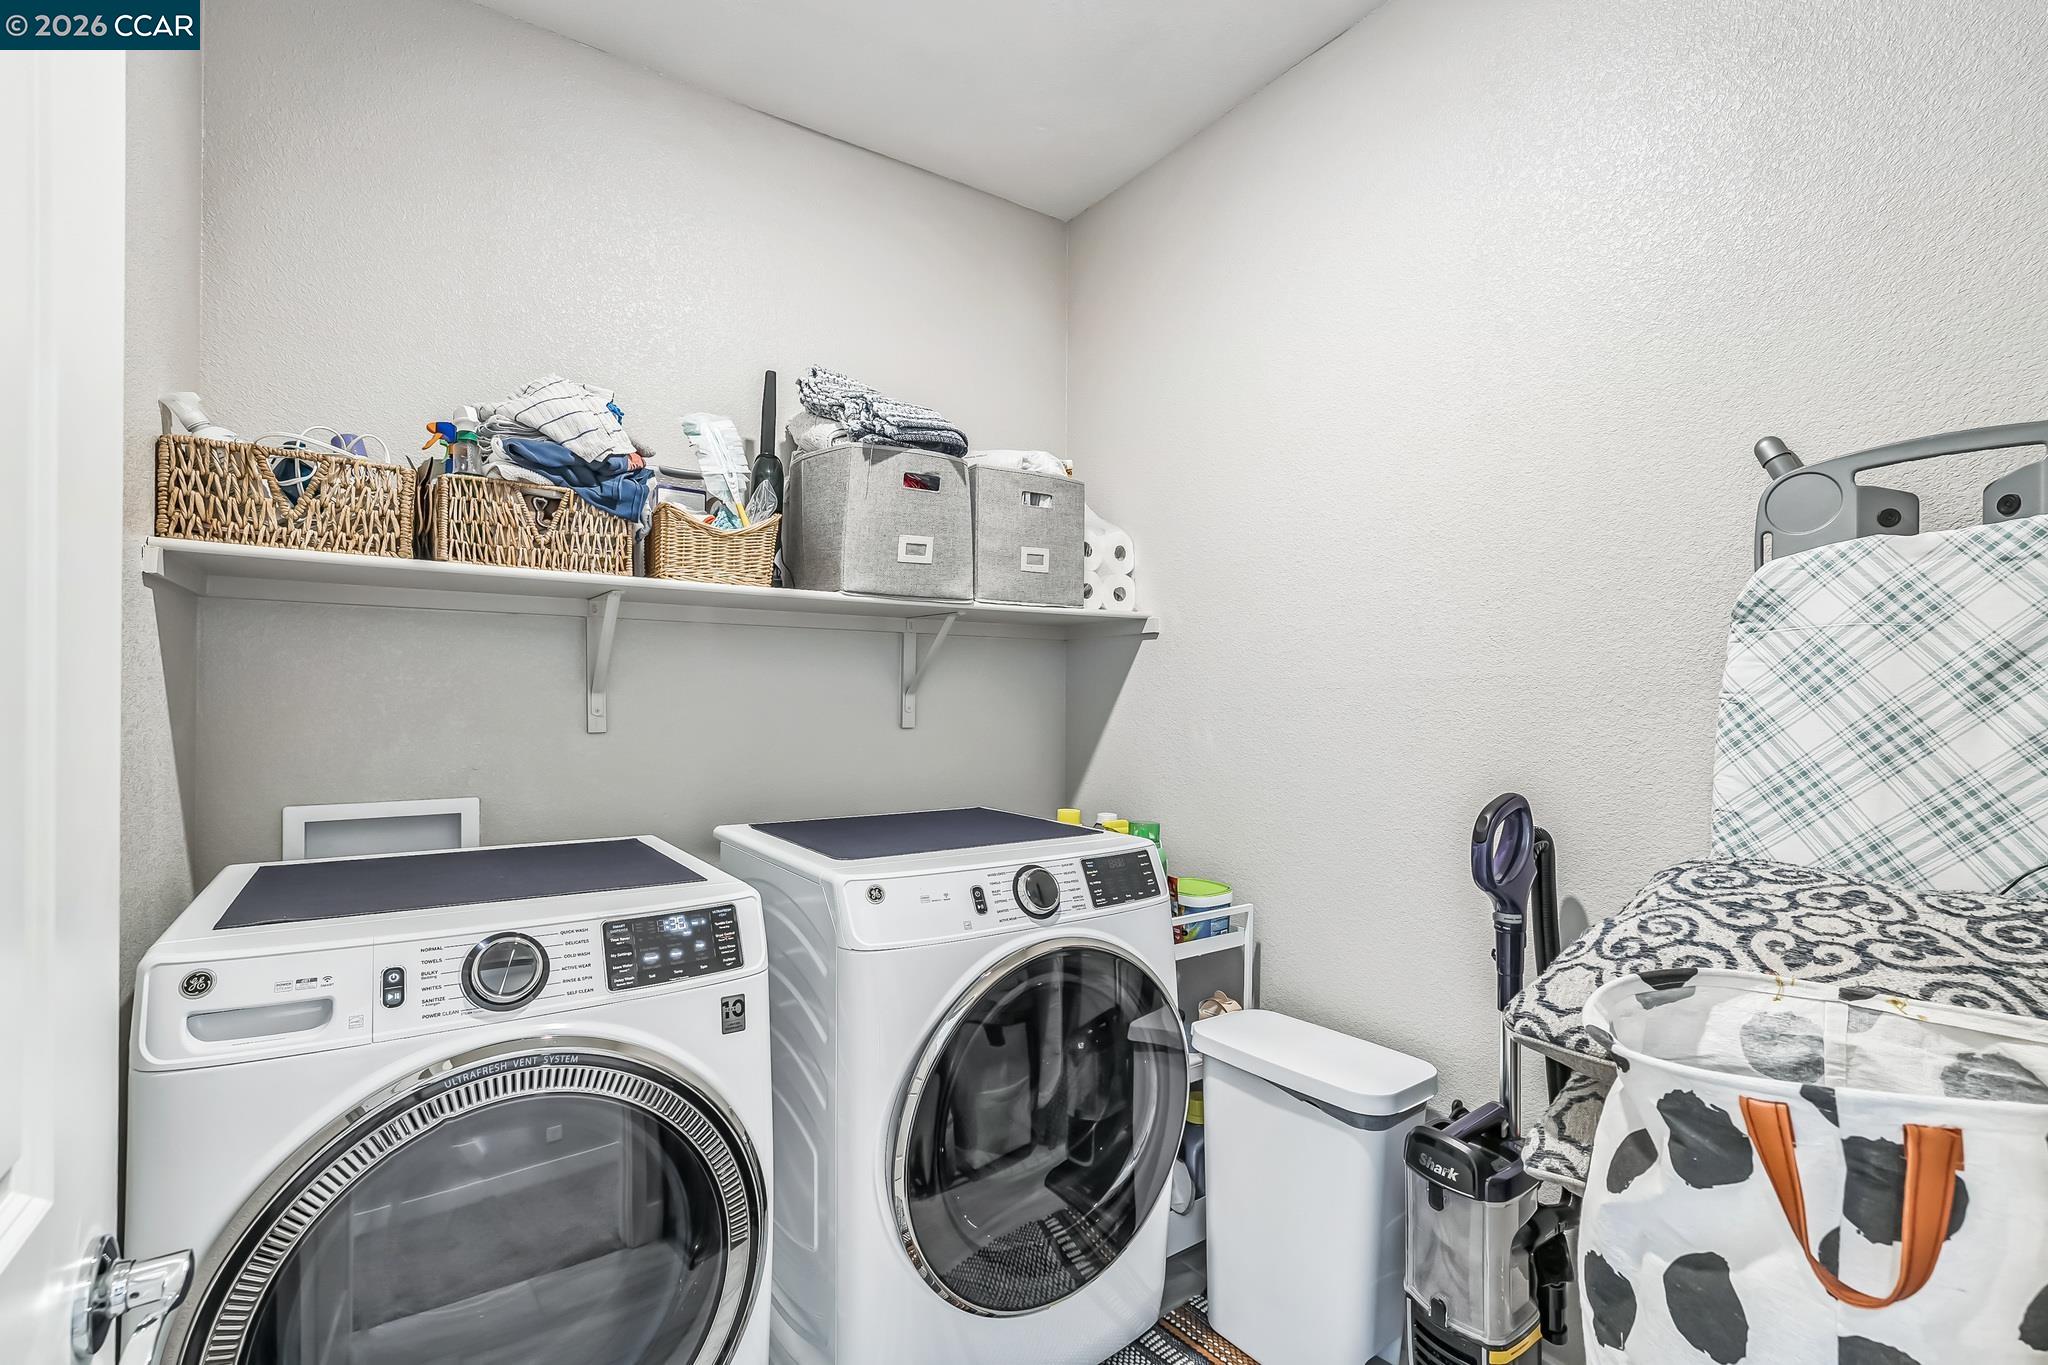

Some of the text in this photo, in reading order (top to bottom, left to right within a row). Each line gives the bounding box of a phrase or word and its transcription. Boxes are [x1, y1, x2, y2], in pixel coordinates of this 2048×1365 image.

[421, 996, 446, 1004] SANITIZE
[721, 998, 746, 1019] 10
[421, 1012, 441, 1020] POWER
[443, 1055, 579, 1089] ULTRAFRESH VENT SYSTEM
[1418, 1152, 1460, 1182] Shark
